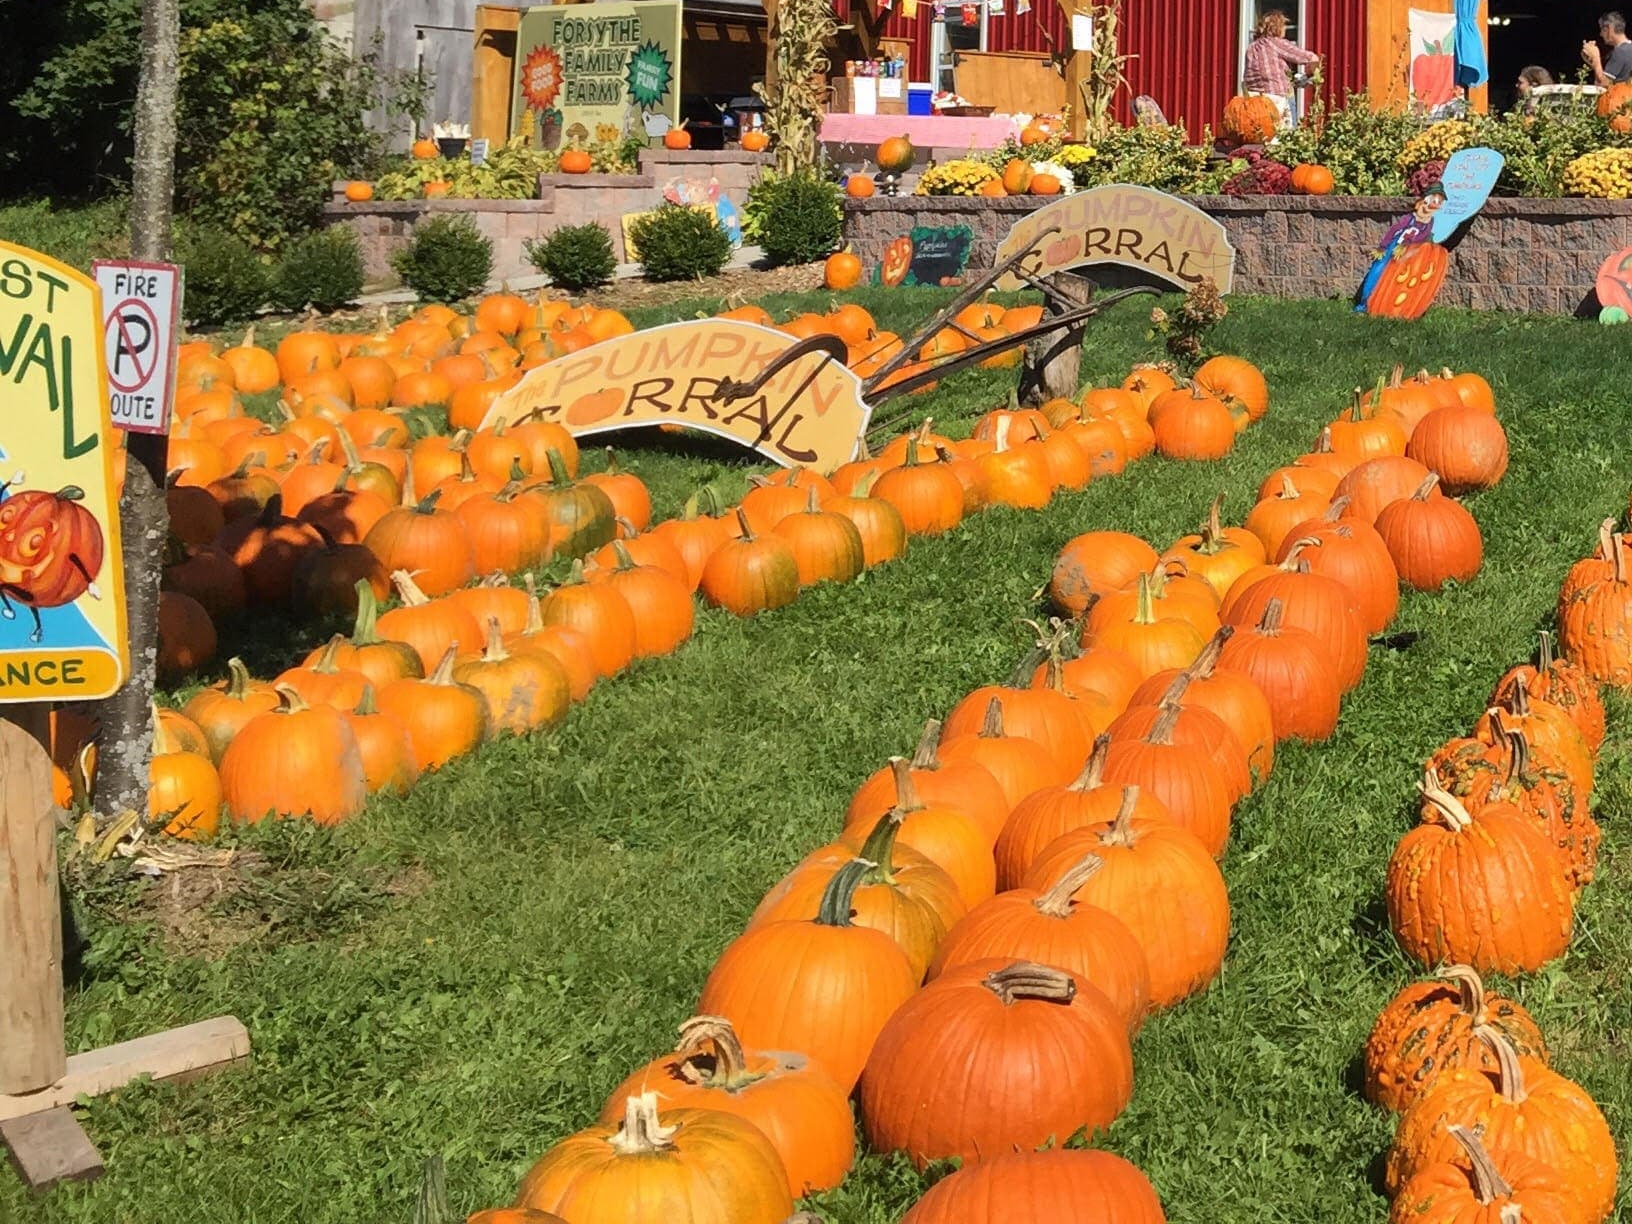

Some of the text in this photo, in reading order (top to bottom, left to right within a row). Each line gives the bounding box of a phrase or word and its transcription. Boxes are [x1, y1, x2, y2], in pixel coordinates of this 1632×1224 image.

[553, 18, 641, 45] FORSYTHE
[564, 50, 625, 74] FAMILY
[566, 79, 622, 102] FARMS
[636, 71, 659, 92] FUN
[1037, 193, 1217, 260] PUMPKIN
[114, 273, 158, 298] FIRE
[552, 330, 844, 417] PUMPKIN
[110, 393, 155, 420] OUTE
[0, 659, 87, 687] NCE
